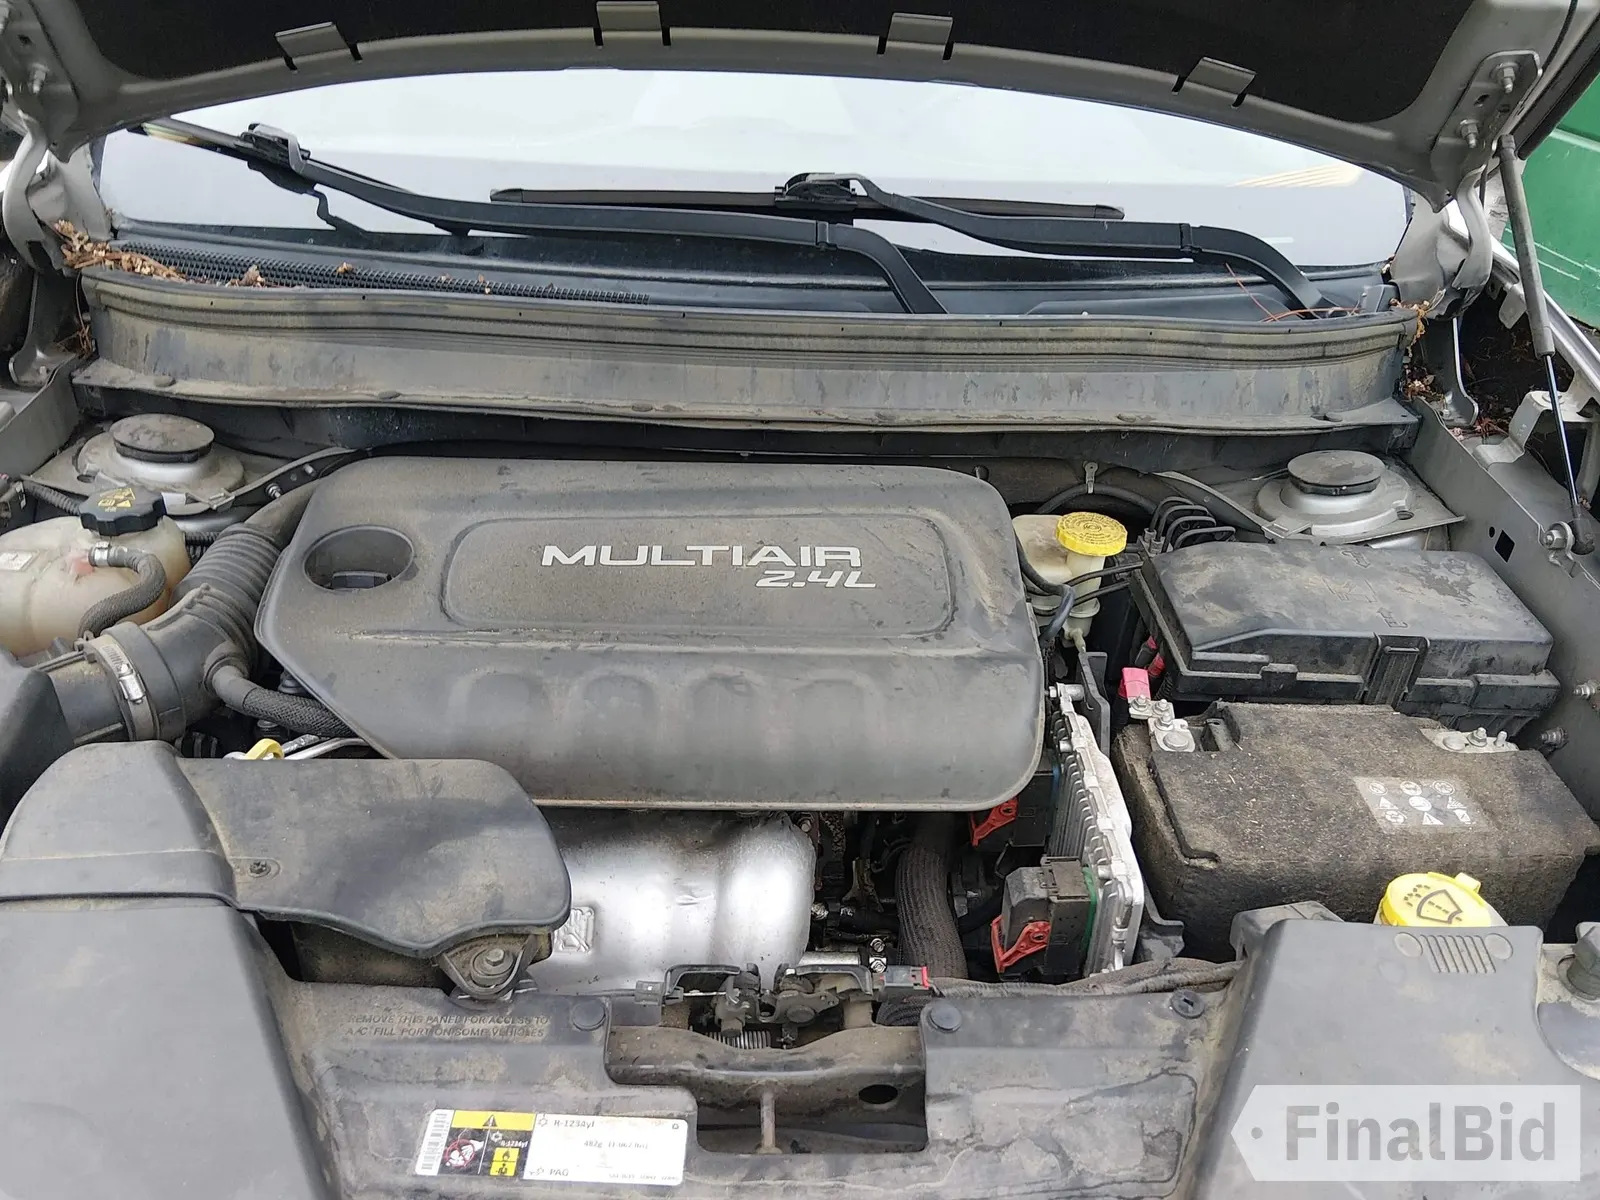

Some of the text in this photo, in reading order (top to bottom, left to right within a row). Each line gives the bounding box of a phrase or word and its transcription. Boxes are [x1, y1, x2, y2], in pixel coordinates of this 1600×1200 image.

[541, 544, 864, 567] MULTIAIR
[755, 569, 877, 588] 2.4L
[534, 1015, 549, 1025] TO
[374, 1026, 396, 1036] FILL
